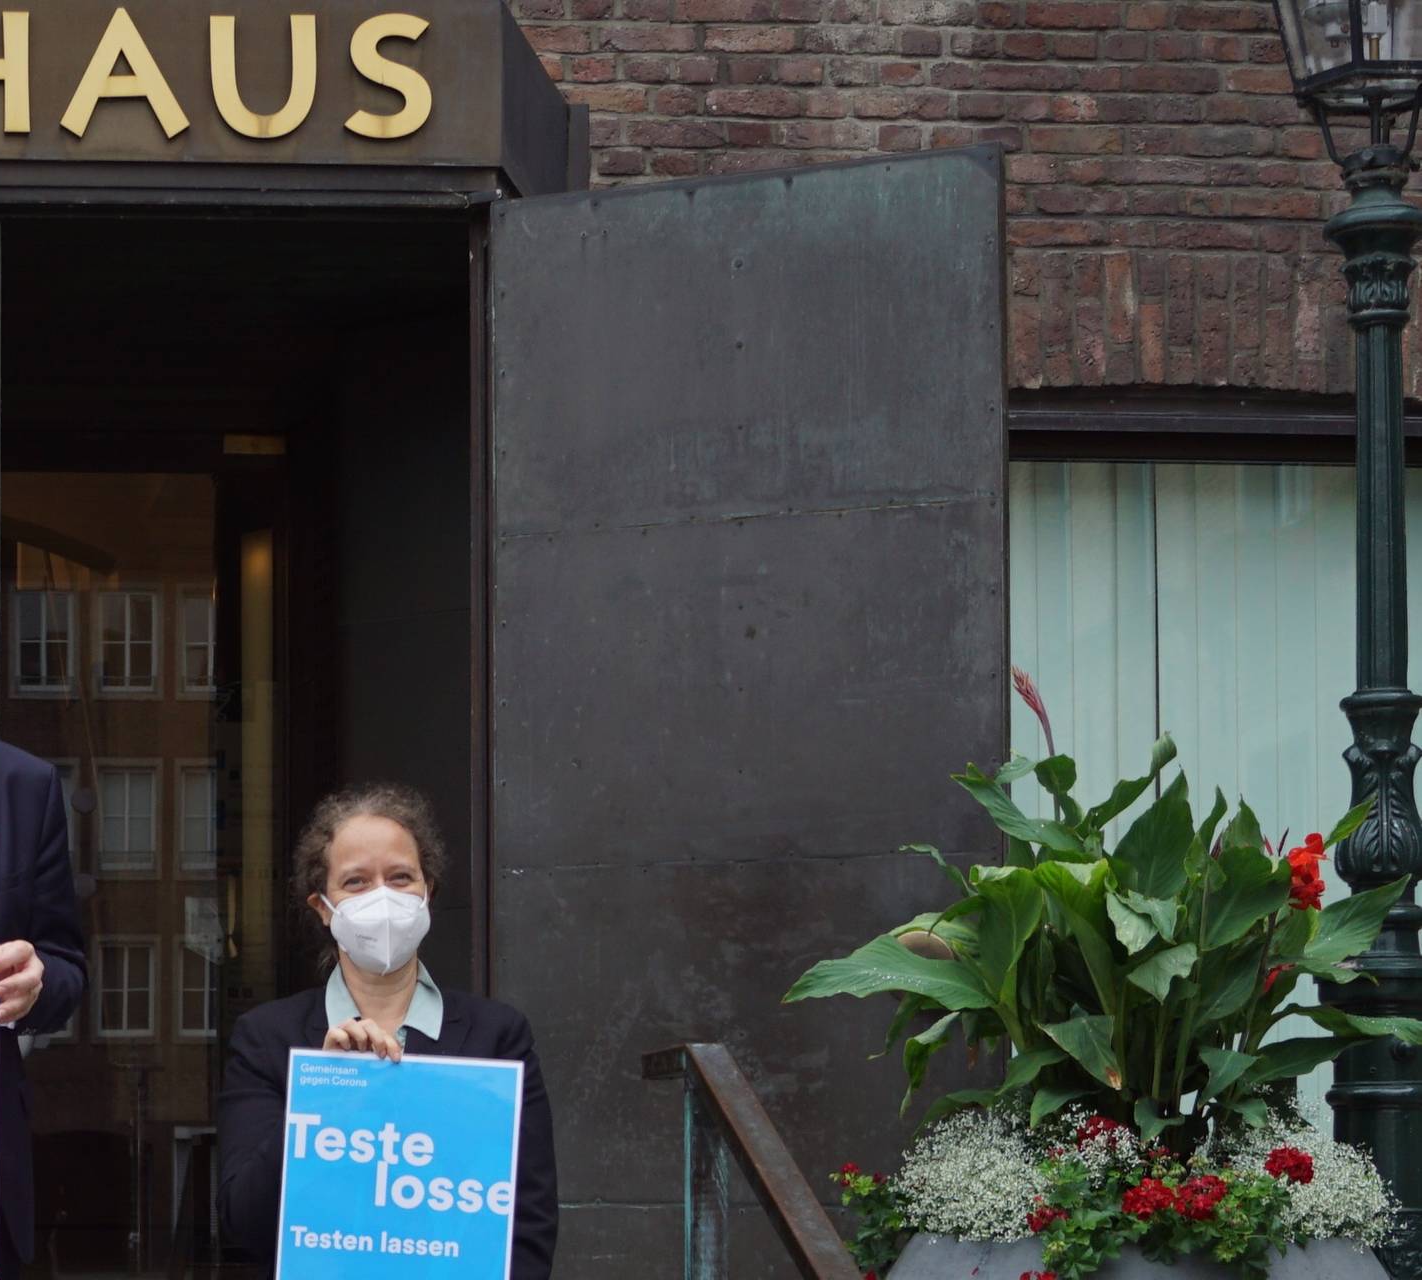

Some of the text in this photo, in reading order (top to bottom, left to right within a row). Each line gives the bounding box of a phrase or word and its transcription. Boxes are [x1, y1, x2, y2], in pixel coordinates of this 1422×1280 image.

[300, 1063, 359, 1075] Gemeinsam
[300, 1075, 368, 1088] gegen Corona
[287, 1112, 435, 1167] Teste
[374, 1160, 514, 1216] losse
[289, 1225, 460, 1258] Testen lassen
